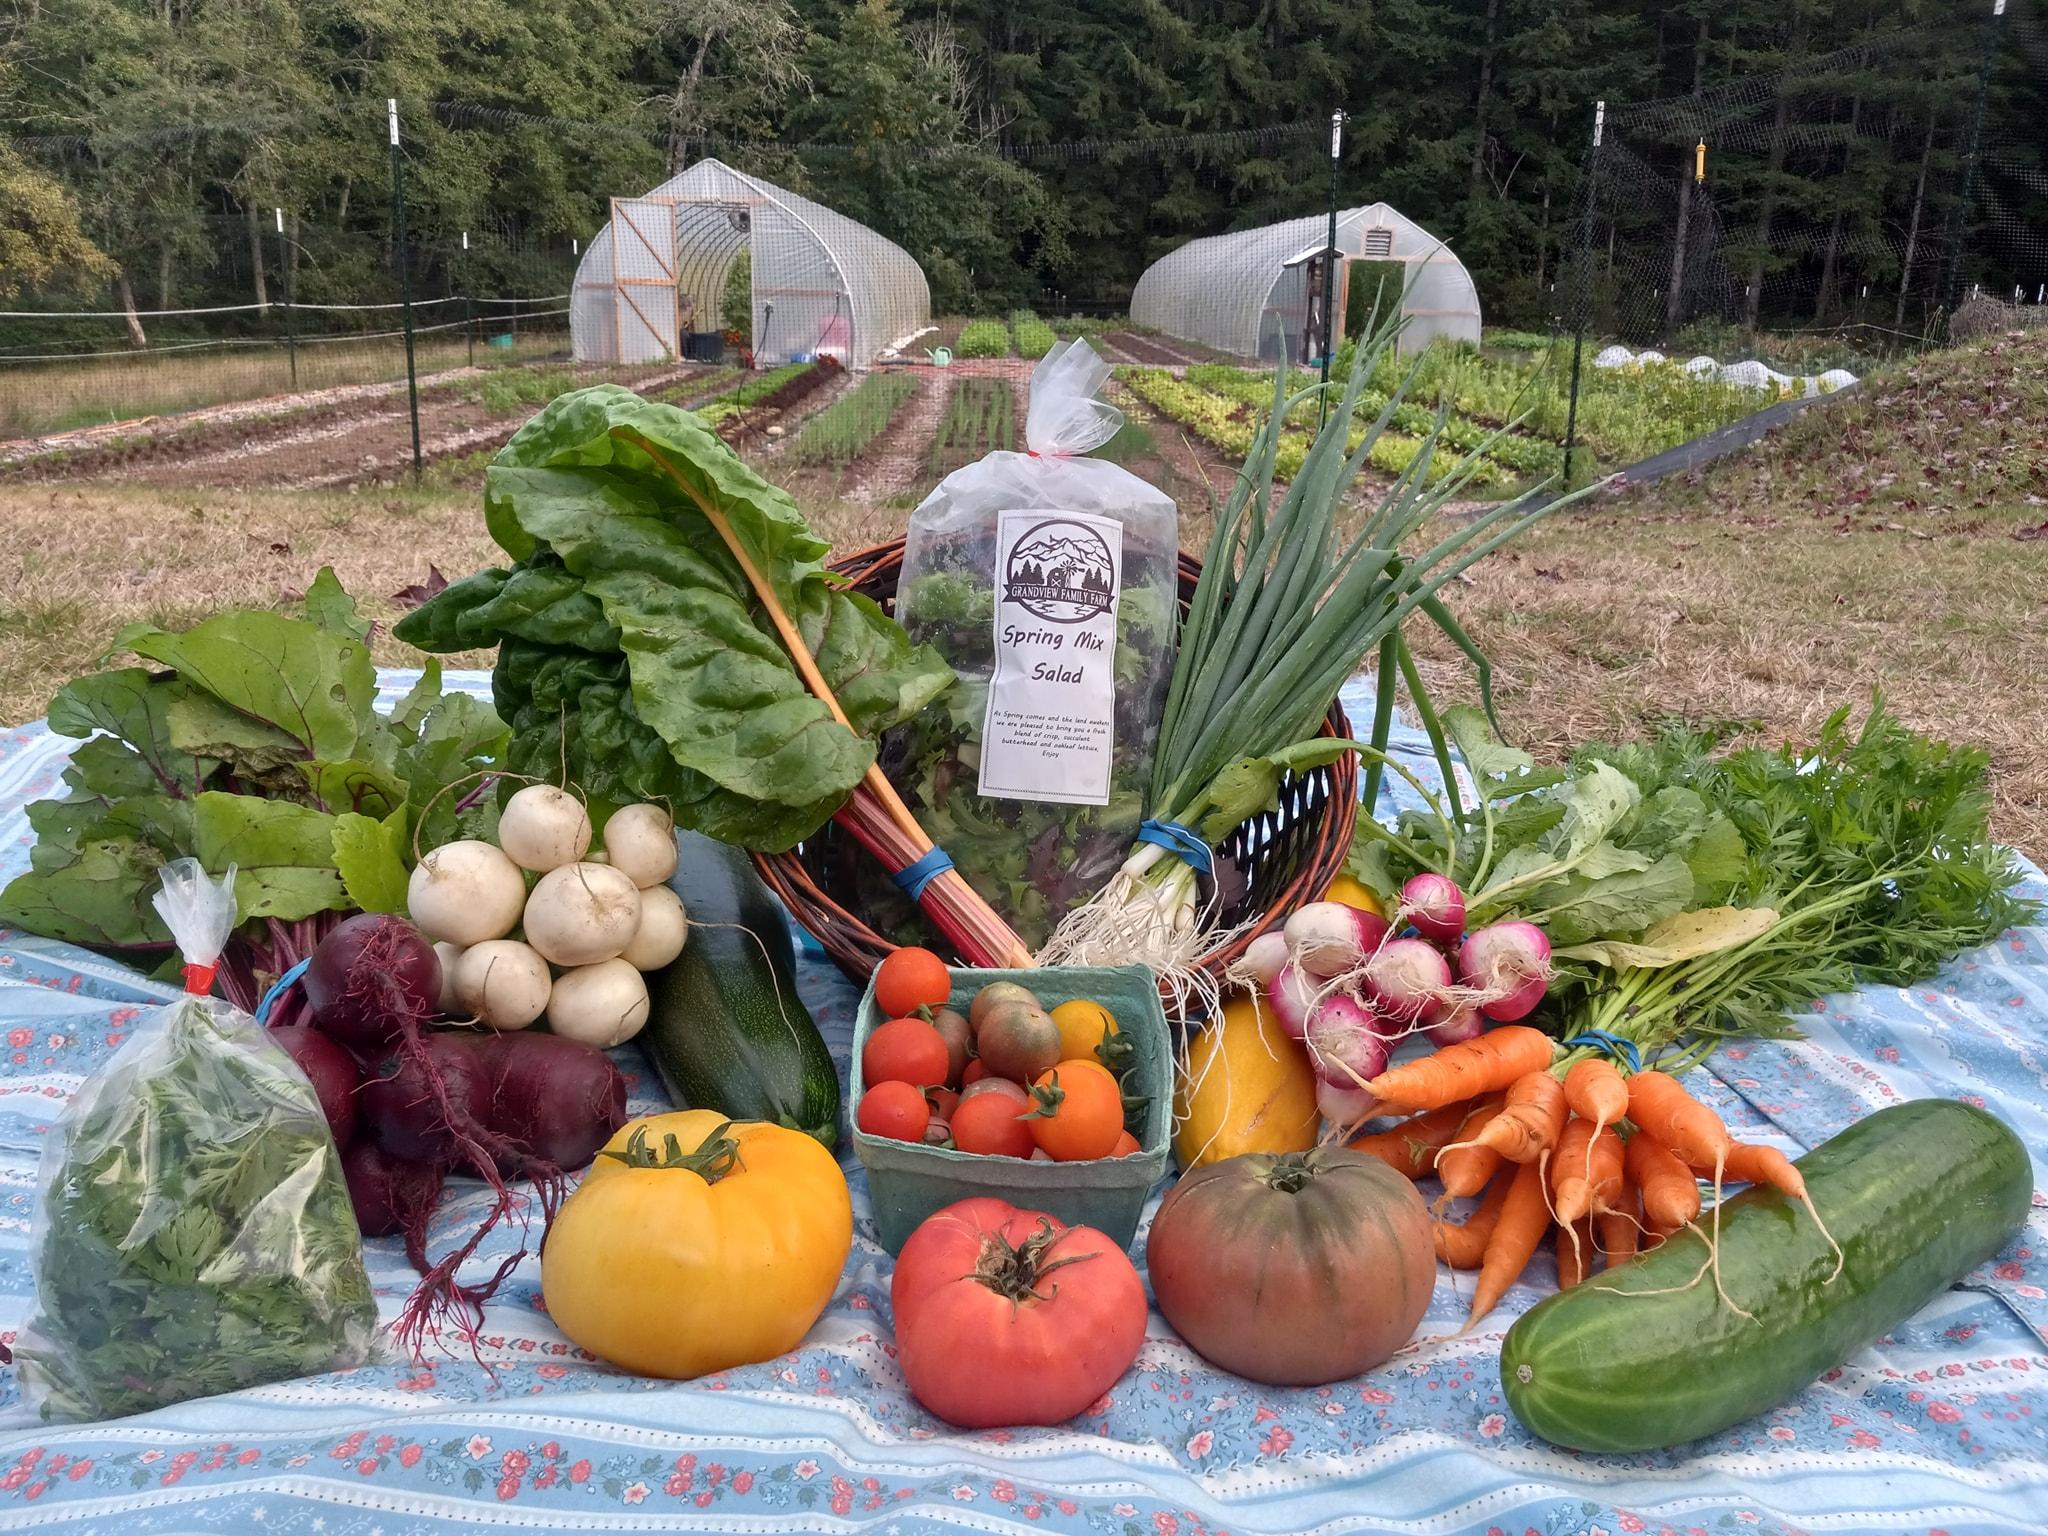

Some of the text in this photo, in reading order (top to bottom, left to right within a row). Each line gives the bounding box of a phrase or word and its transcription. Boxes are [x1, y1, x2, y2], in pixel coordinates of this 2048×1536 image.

[1011, 586, 1109, 607] GRANDVIEW FAMILY FARM
[1002, 625, 1104, 651] Spring Mix
[1031, 662, 1084, 684] Salad
[1003, 711, 1024, 720] Spring
[1092, 727, 1106, 735] fresh
[1001, 737, 1038, 746] butterhead
[1044, 733, 1060, 741] crisp,
[1042, 749, 1060, 758] Enjoy
